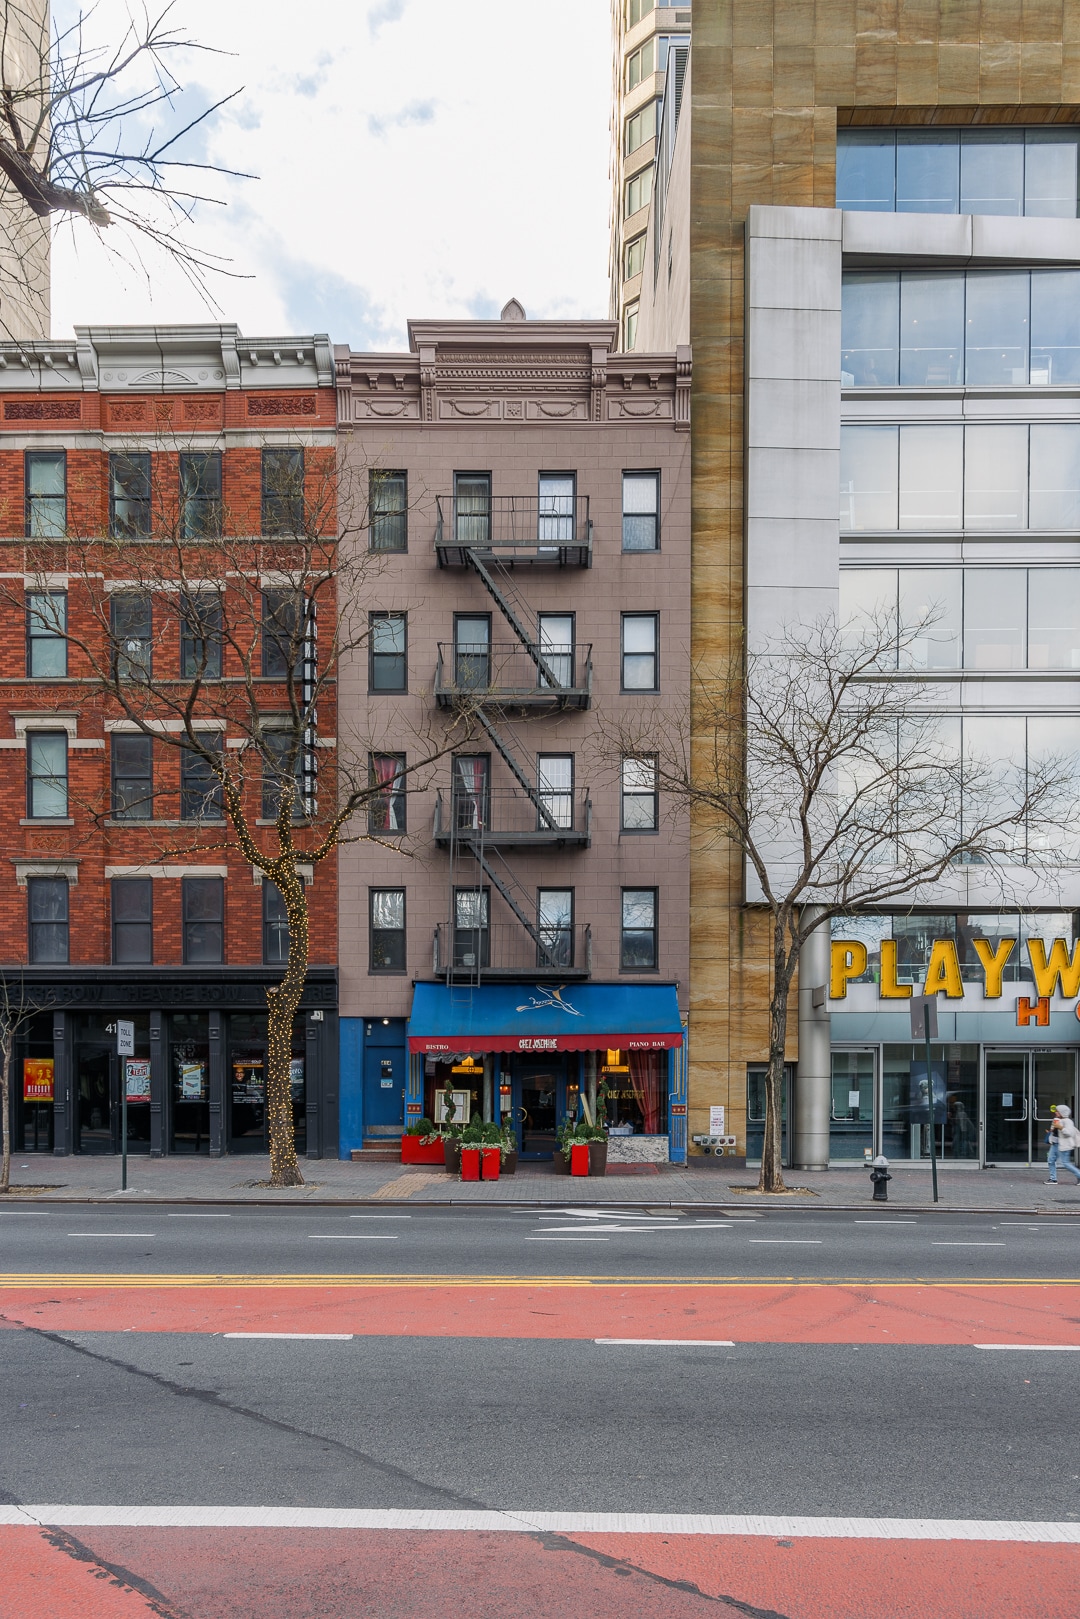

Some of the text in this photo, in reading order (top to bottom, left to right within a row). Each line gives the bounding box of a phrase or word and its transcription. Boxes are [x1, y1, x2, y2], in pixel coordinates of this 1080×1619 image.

[829, 938, 1080, 998] PLAYW
[120, 1039, 132, 1047] ZONE
[518, 1039, 557, 1049] CHEZ JOSEPHINE
